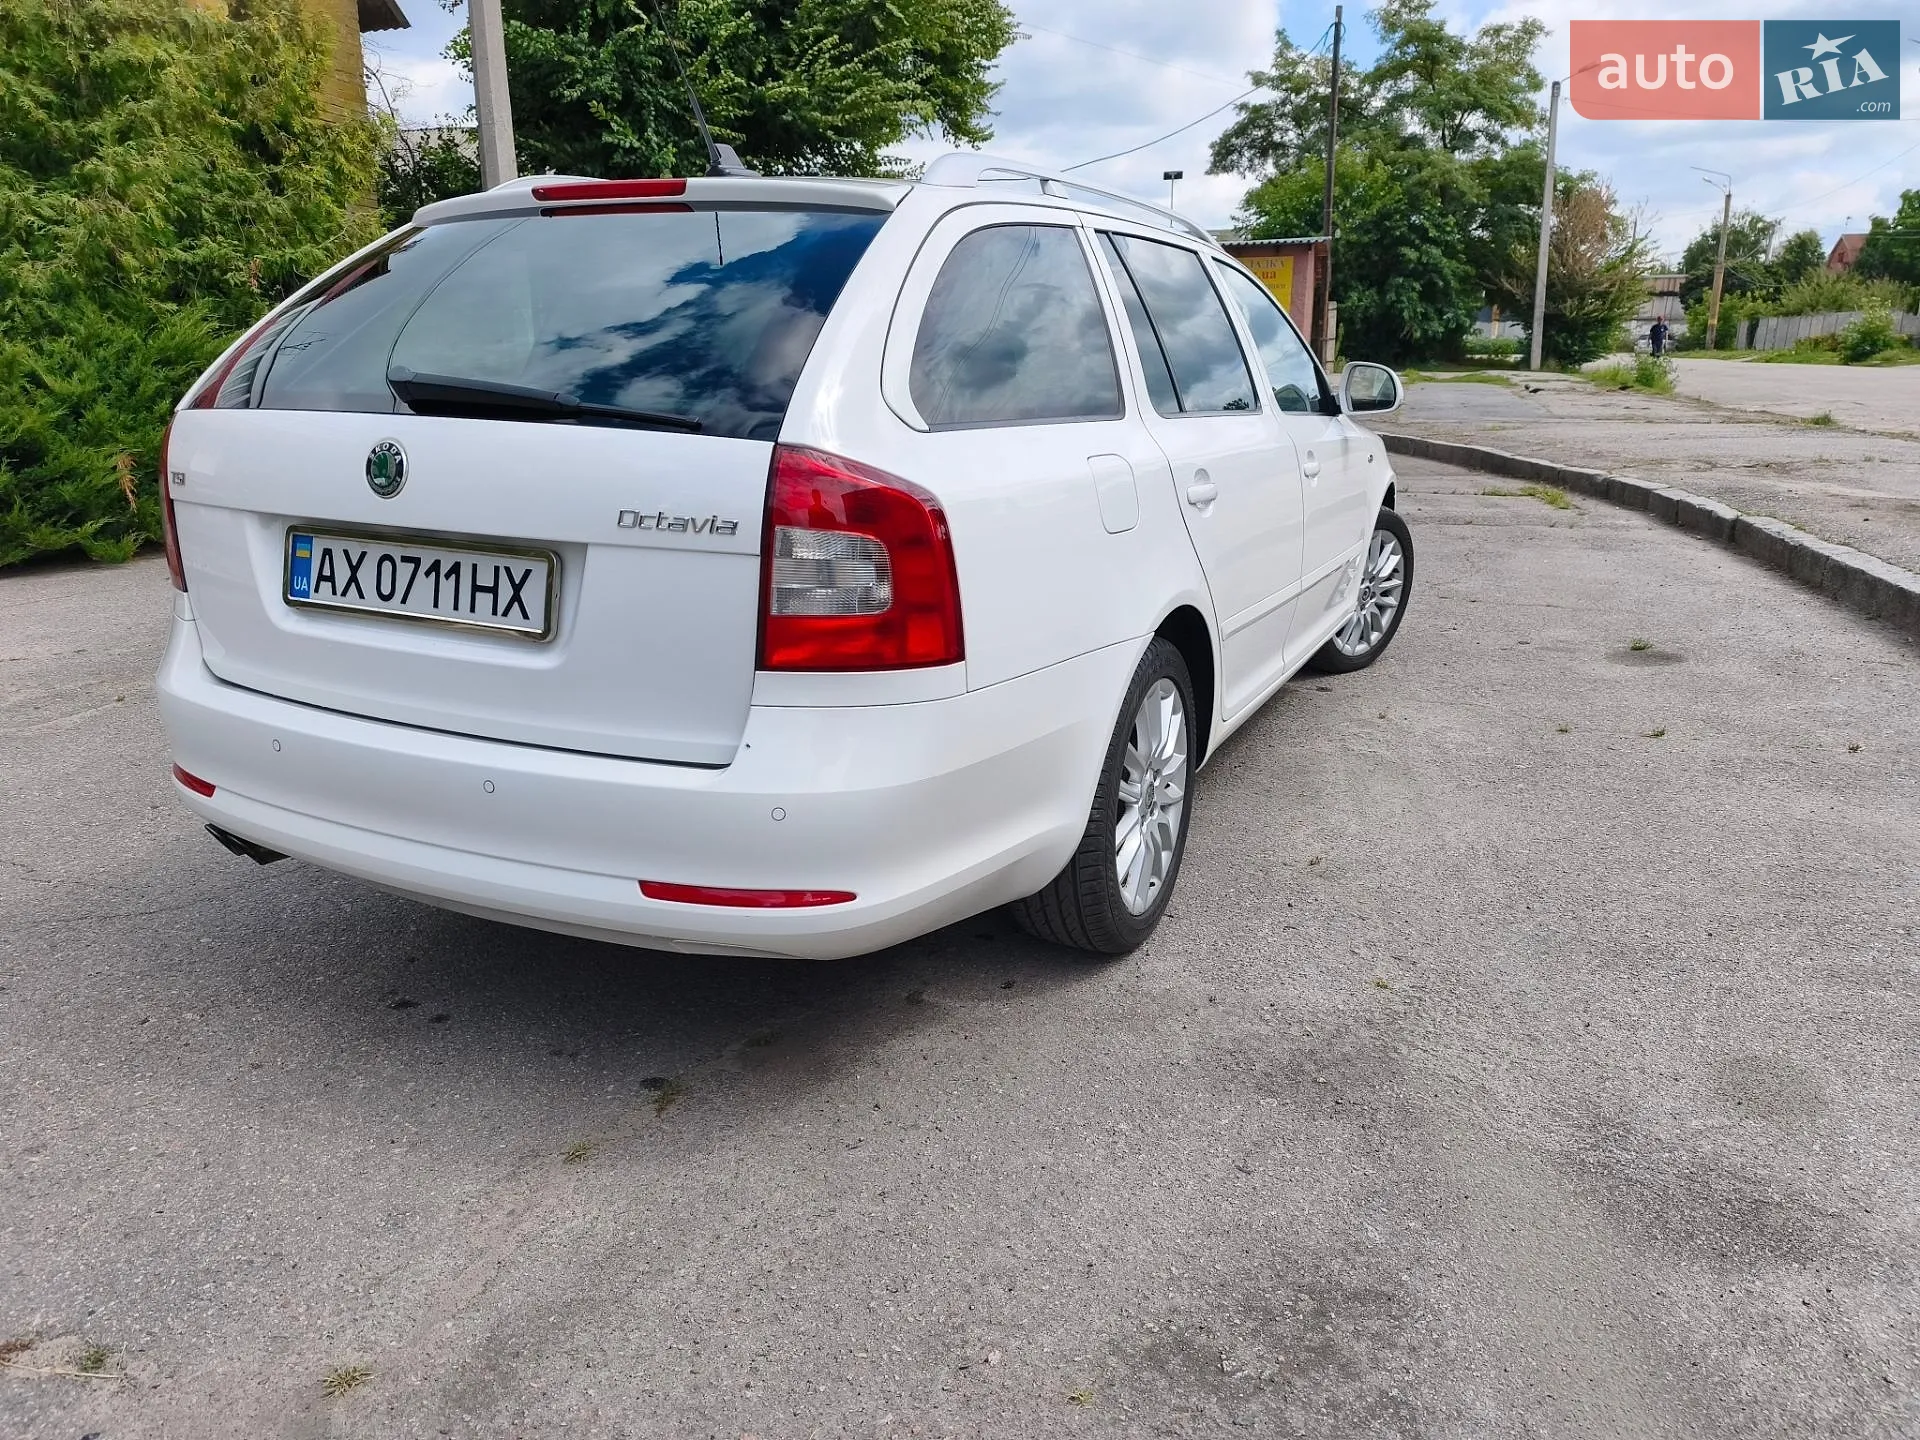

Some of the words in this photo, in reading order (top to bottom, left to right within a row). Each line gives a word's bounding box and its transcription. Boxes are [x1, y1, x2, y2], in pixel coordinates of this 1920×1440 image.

[617, 508, 740, 536] Octavia
[293, 575, 309, 593] UA
[313, 547, 368, 600] AX
[375, 553, 463, 612] 0711
[469, 562, 533, 620] HX
